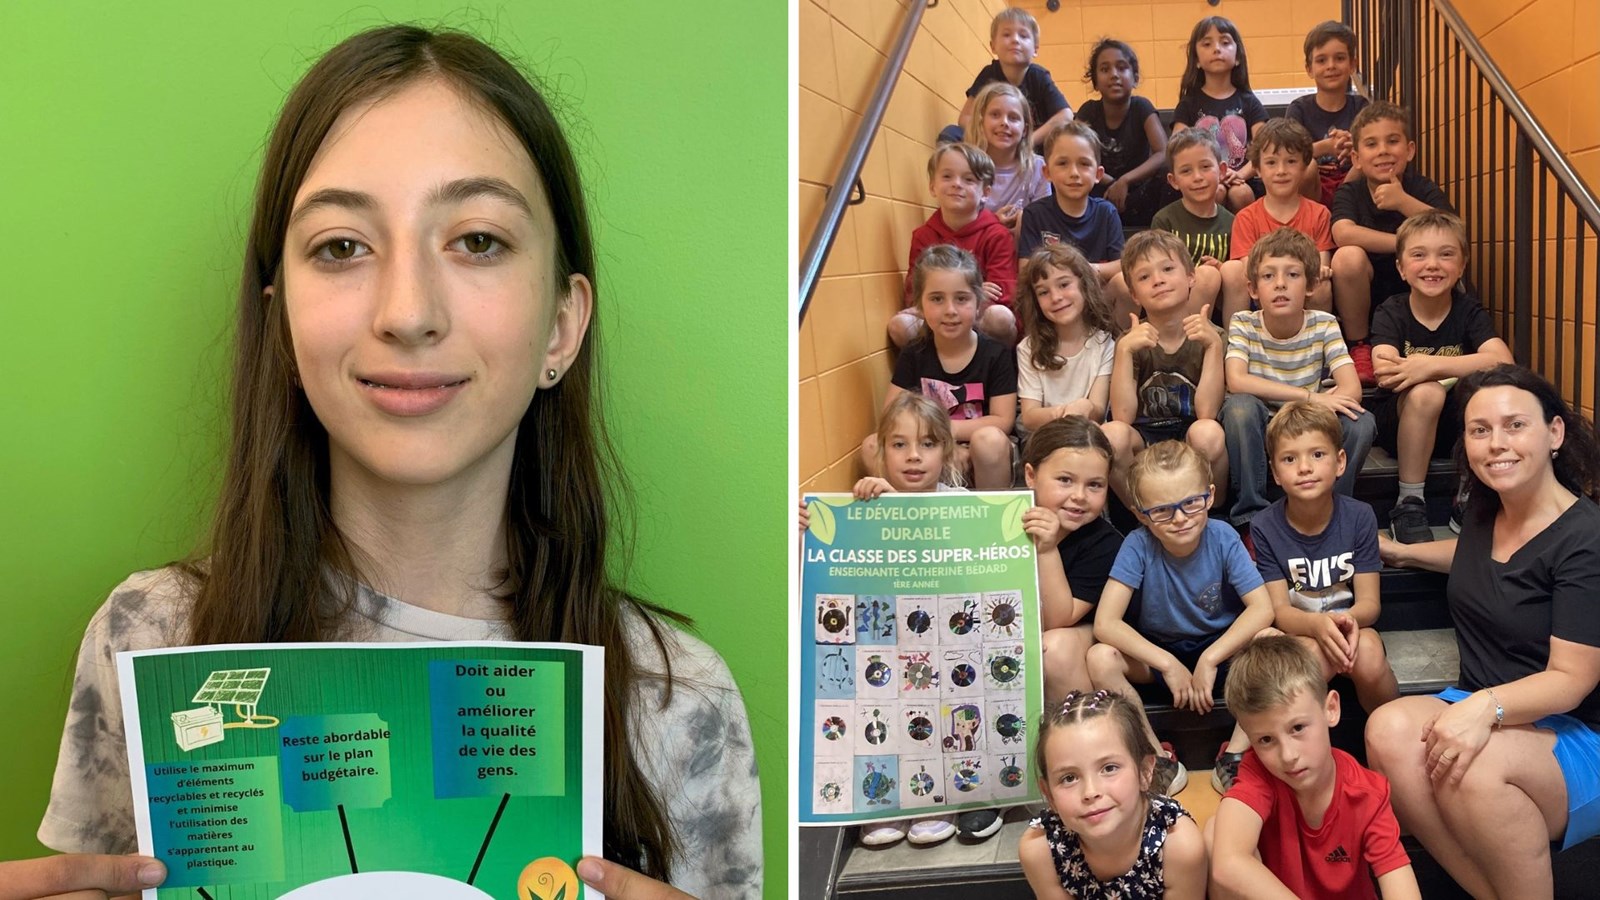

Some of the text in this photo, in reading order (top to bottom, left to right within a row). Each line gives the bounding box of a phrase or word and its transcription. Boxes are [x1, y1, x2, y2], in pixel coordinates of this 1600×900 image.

[847, 503, 989, 521] LE DÉVELOPPEMENT
[881, 526, 951, 541] DURABLE
[807, 542, 1031, 564] LA CLASSE DES SUPER-HÉROS
[829, 562, 1008, 577] ENSEIGNANTE CATHERINE BÉDARD
[1288, 552, 1354, 588] EVI'S
[893, 579, 940, 588] 1ÈRE ANNÉE
[455, 664, 535, 677] Doit aider
[485, 686, 506, 697] ou
[457, 704, 535, 717] améliorer
[282, 728, 391, 747] Reste abordable
[462, 724, 536, 740] la qualité
[303, 747, 373, 763] sur le plan
[458, 744, 536, 756] de vie des
[153, 762, 255, 776] Utilise le maximum
[302, 765, 379, 783] budgétaire.
[477, 765, 518, 780] gens.
[149, 787, 264, 804] recyclables et recyclés
[177, 803, 238, 815] et minimise
[230, 816, 248, 825] des
[187, 830, 233, 841] matières
[168, 843, 255, 856] s'apparentant au
[187, 857, 237, 870] plastique.
